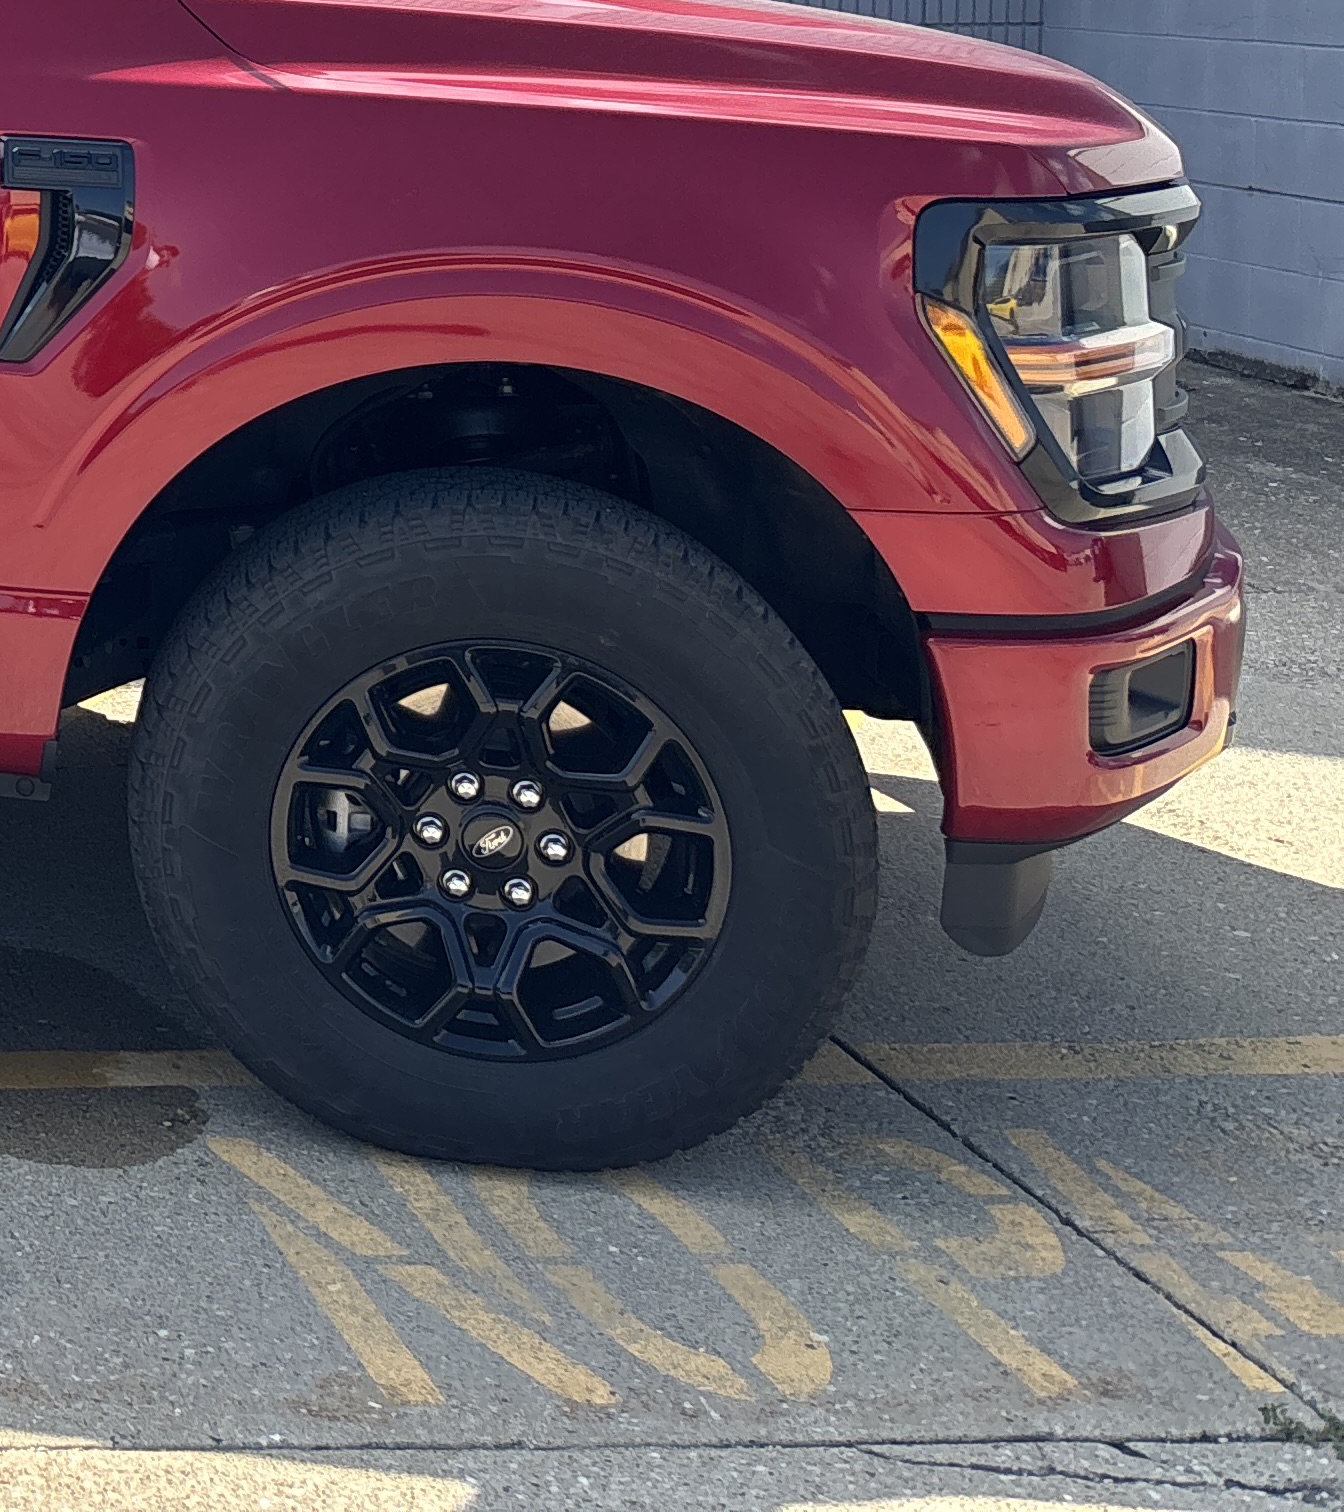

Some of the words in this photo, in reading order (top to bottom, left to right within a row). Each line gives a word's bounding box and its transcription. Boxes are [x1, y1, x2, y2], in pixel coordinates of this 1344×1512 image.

[12, 146, 119, 170] F-150
[477, 829, 509, 856] Ford
[205, 1136, 833, 1405] NO
